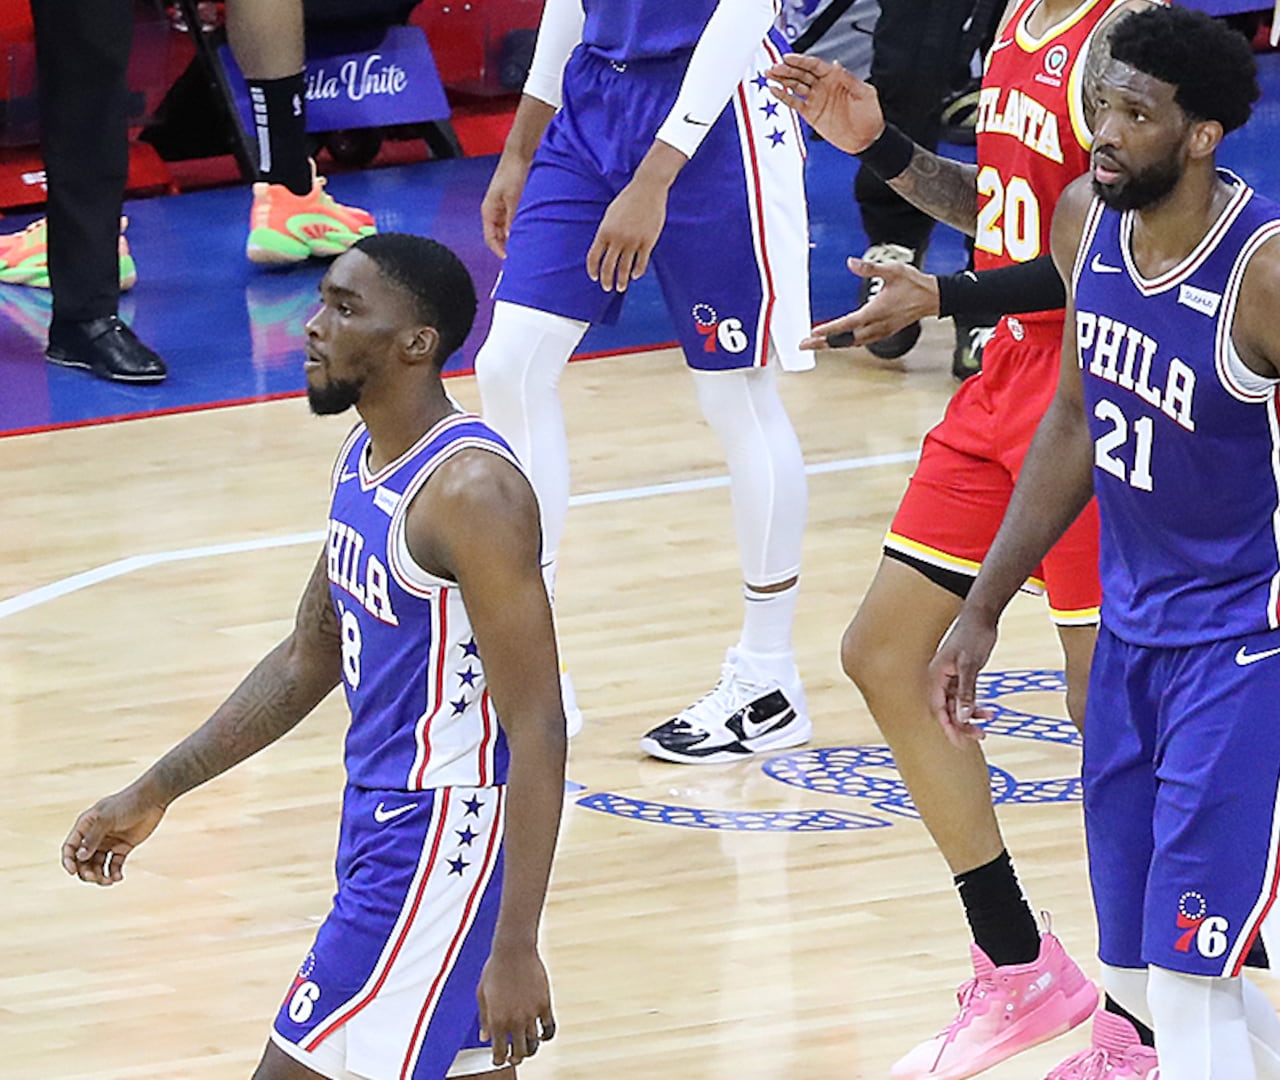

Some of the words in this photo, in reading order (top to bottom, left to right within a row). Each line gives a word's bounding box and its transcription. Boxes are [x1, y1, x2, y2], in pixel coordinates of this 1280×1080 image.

[304, 69, 340, 101] ila
[340, 54, 408, 101] Unite
[975, 87, 1064, 165] TLANTA
[974, 166, 1040, 262] 20
[699, 317, 748, 354] 76
[1076, 311, 1197, 433] PHILA
[1093, 398, 1154, 492] 21
[327, 519, 400, 626] HILA
[337, 600, 362, 691] 8
[1174, 909, 1229, 959] 76
